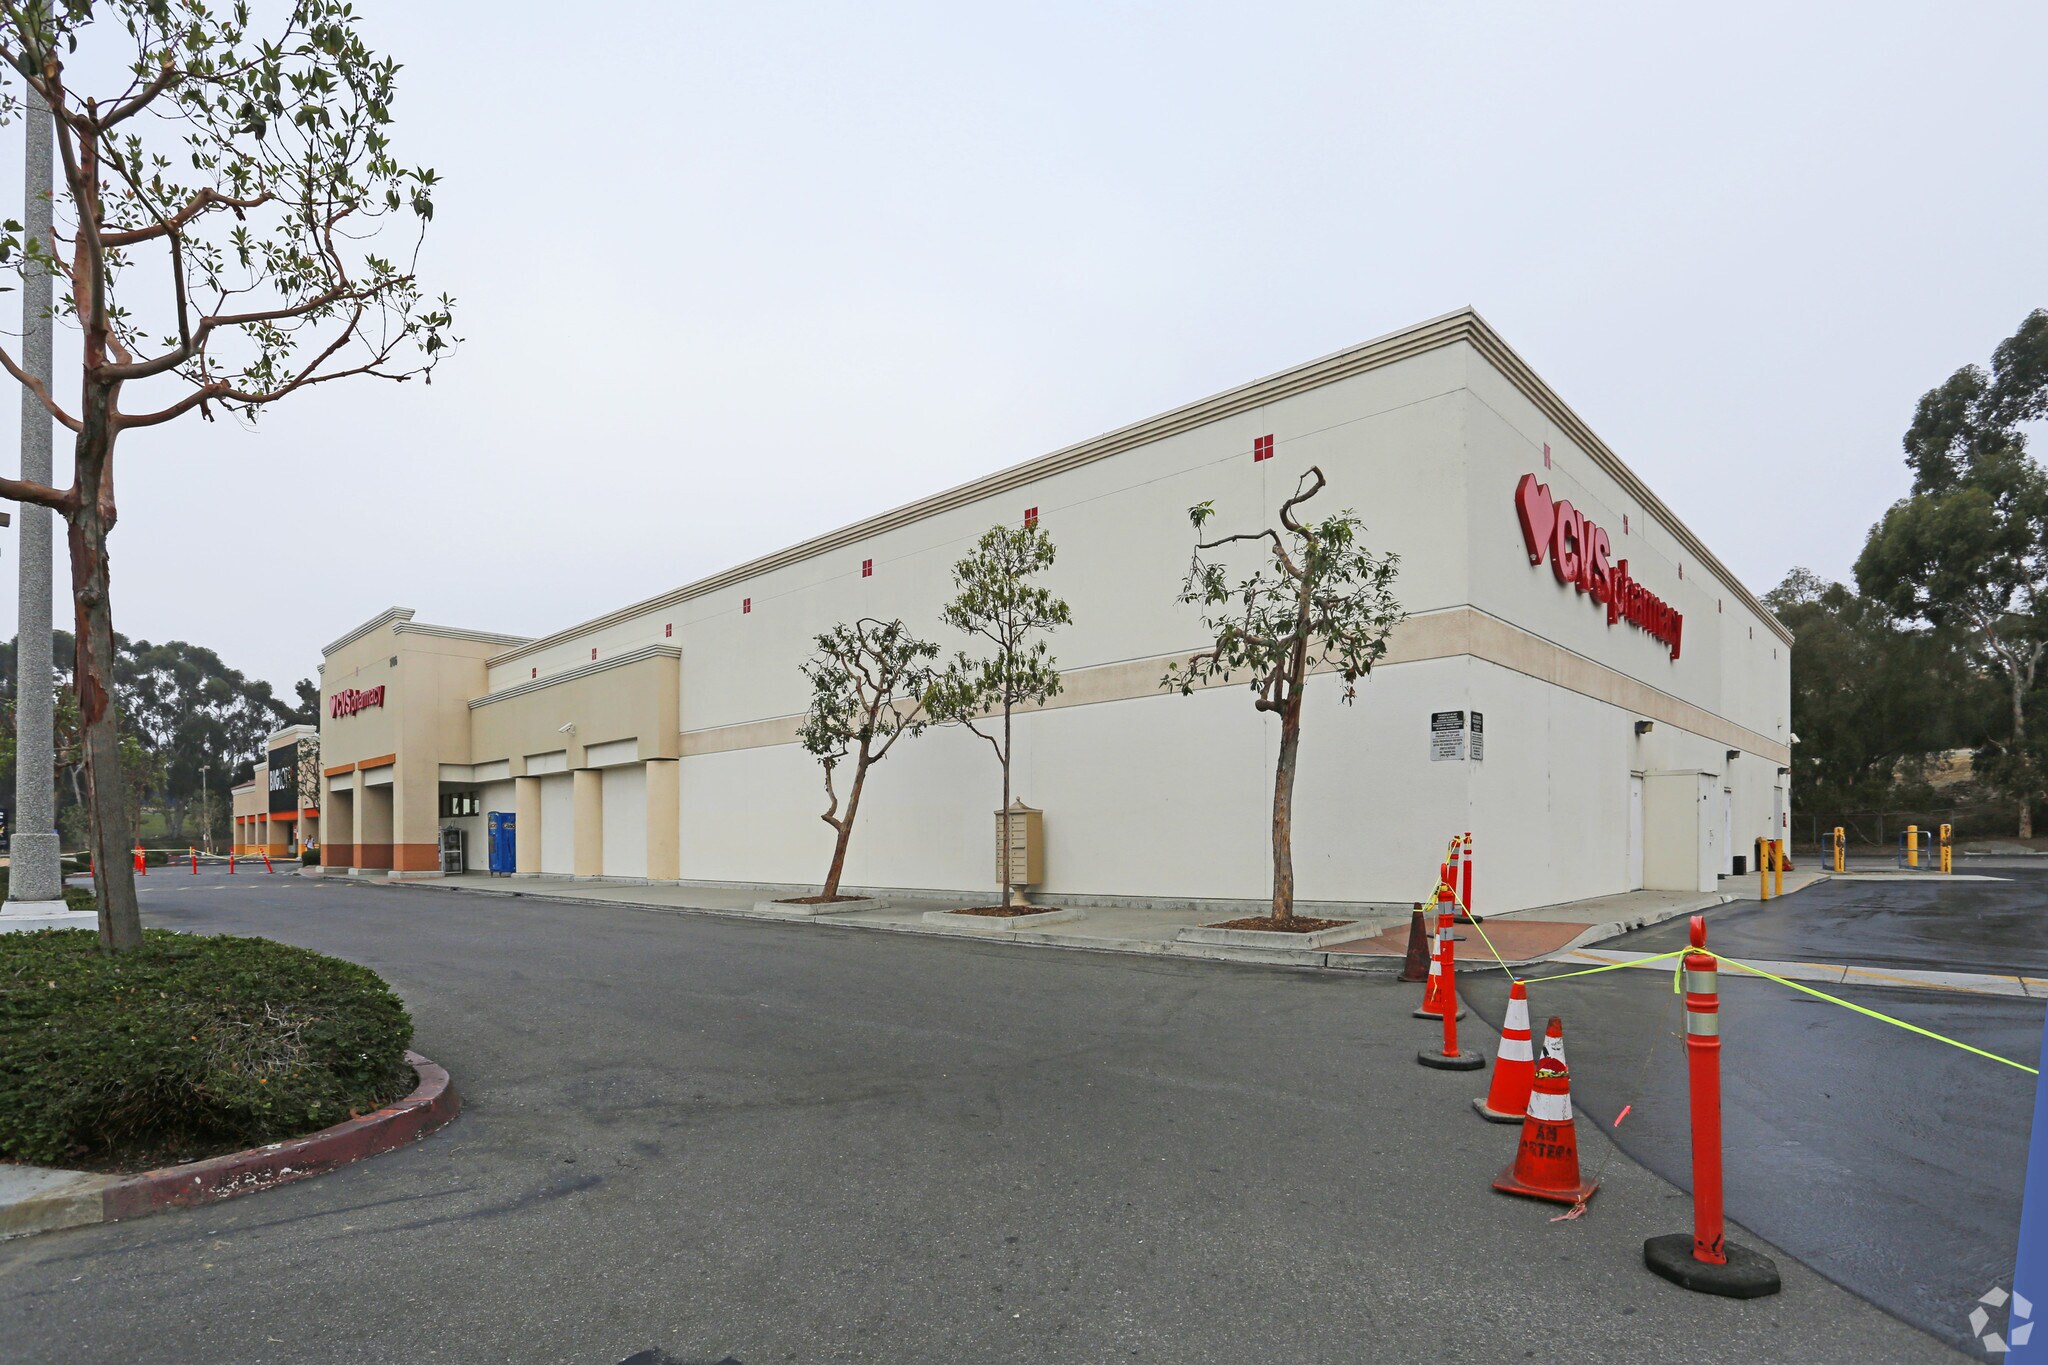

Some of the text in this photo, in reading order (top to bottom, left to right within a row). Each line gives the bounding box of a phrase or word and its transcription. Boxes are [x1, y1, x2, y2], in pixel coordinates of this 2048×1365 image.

[1550, 500, 1682, 660] CVS pharmacy
[336, 685, 385, 717] CVS pharmacy
